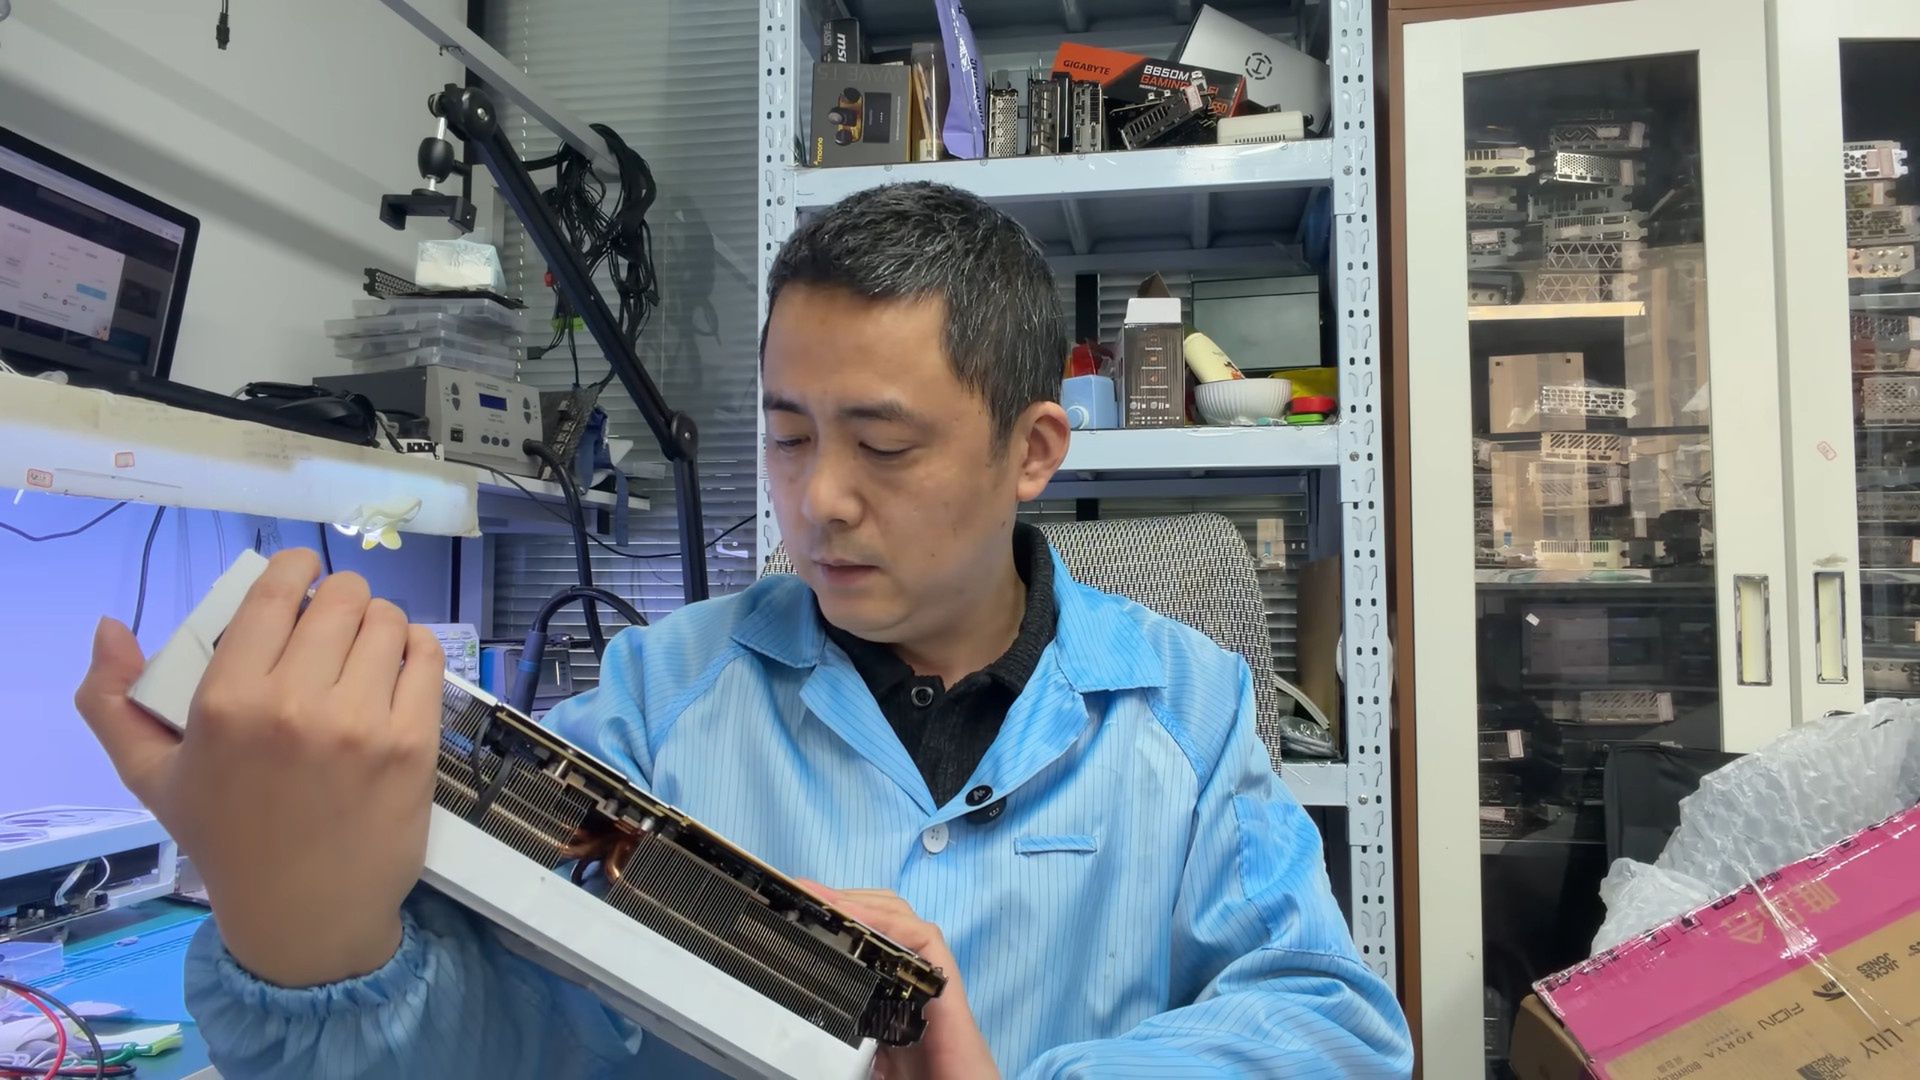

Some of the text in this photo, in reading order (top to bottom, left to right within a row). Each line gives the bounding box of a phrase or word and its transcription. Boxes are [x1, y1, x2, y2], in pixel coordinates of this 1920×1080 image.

[837, 33, 847, 62] msi
[1063, 59, 1111, 76] GIGABYTE
[1144, 65, 1189, 81] B650M
[1856, 952, 1891, 974] JONES
[1864, 959, 1900, 982] JACK&
[1859, 1028, 1904, 1059] LILY
